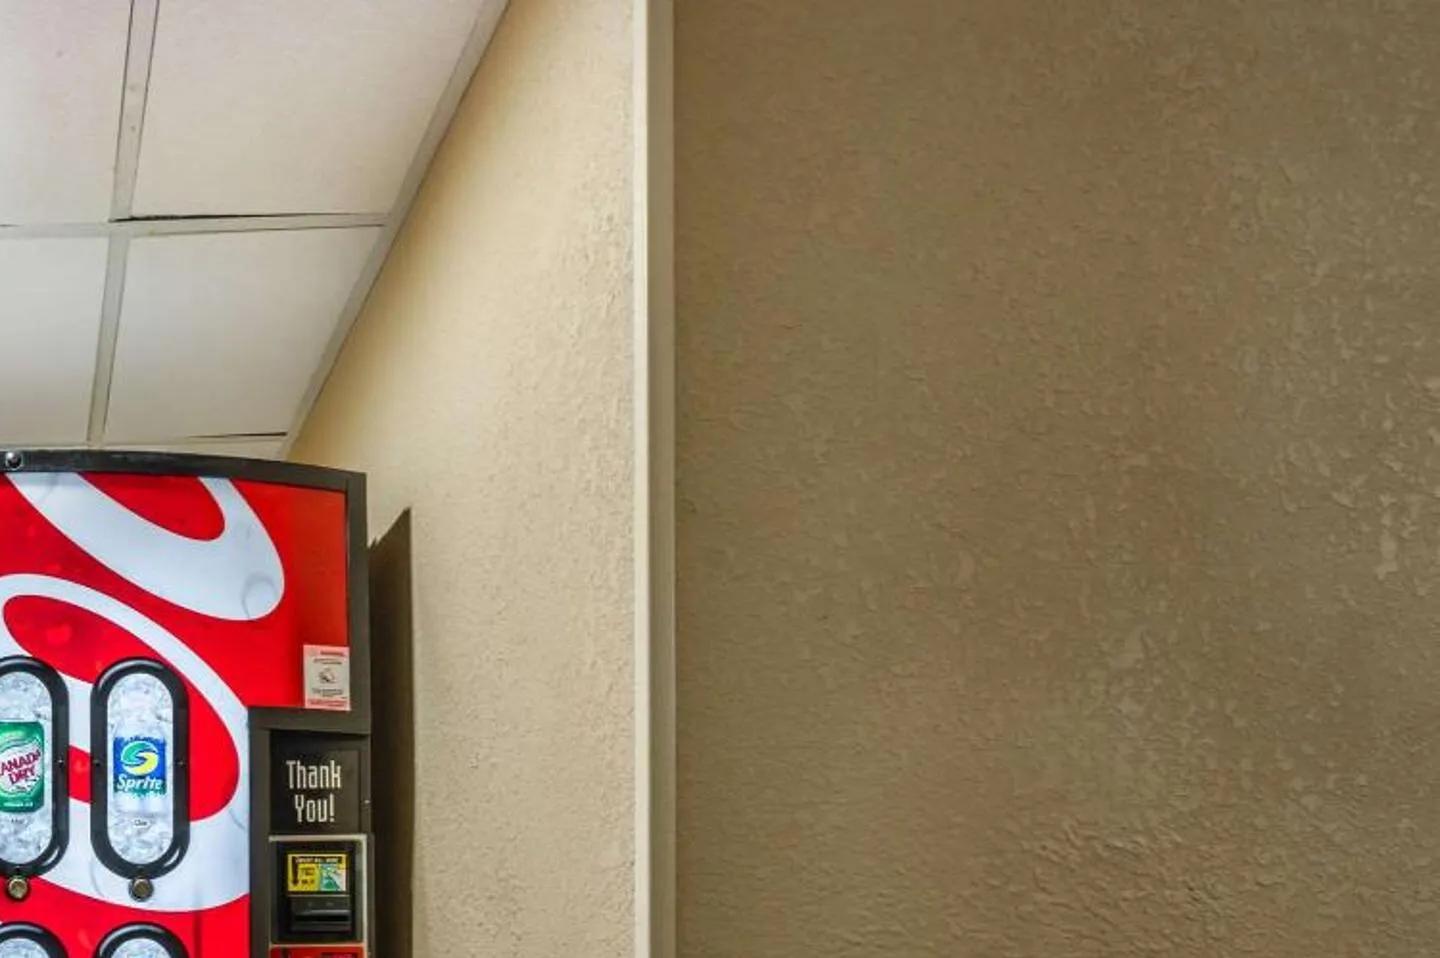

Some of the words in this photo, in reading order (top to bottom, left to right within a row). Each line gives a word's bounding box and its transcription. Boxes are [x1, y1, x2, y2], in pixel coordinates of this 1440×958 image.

[8, 764, 35, 784] DRY
[117, 774, 162, 792] Sprite
[286, 760, 342, 789] Thank
[294, 794, 335, 823] You!
